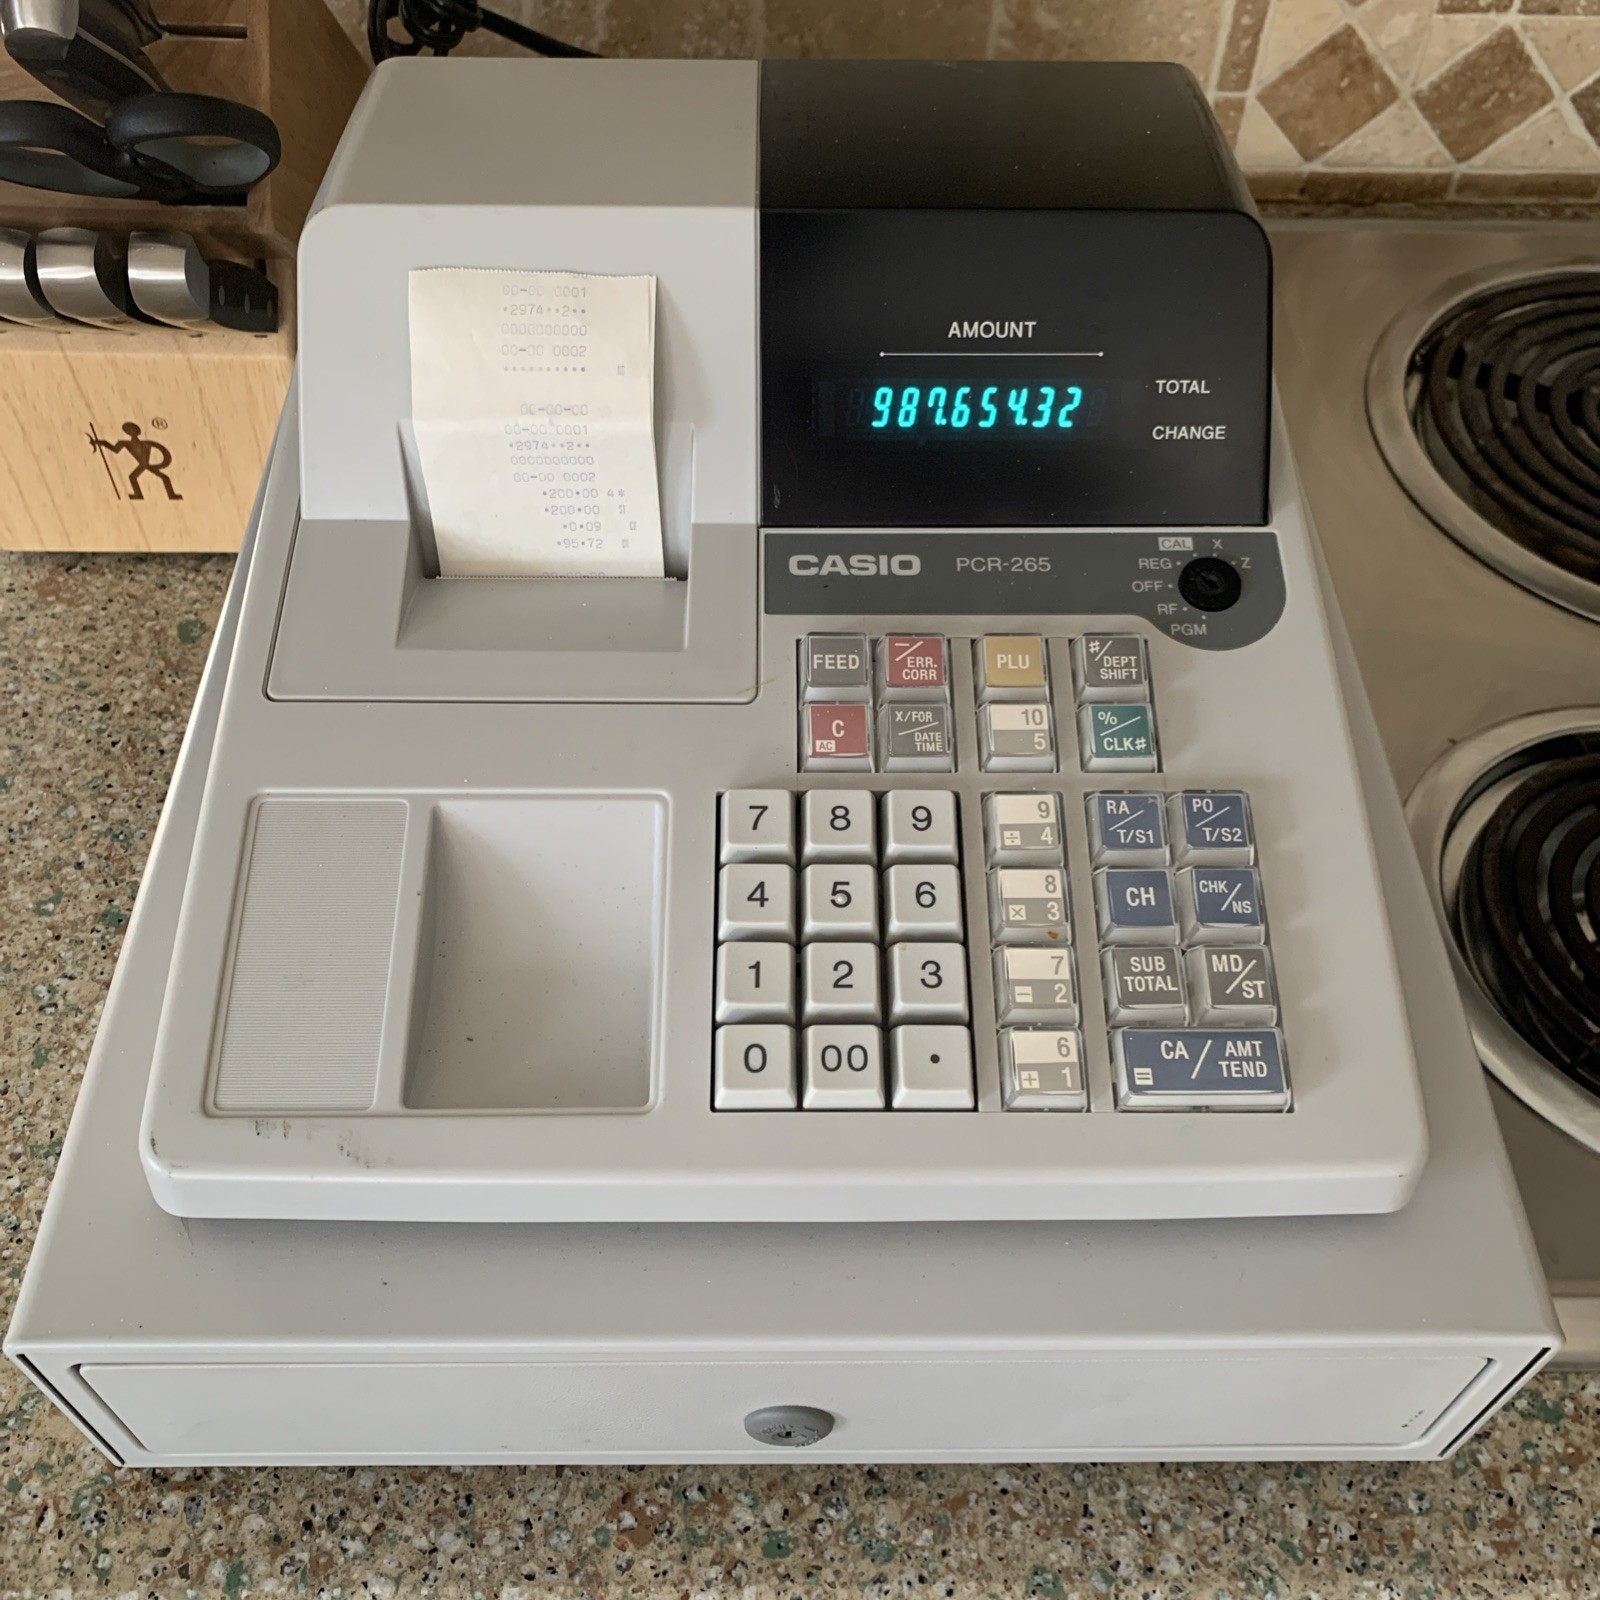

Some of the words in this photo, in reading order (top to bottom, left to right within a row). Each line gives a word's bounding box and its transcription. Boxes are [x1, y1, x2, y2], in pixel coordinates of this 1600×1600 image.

[948, 321, 1037, 339] AMOUNT
[553, 344, 587, 358] 0002
[1155, 379, 1211, 395] TOTAL
[555, 424, 588, 436] 0001
[1151, 426, 1227, 441] CHANGE
[563, 472, 596, 483] 0002
[1161, 539, 1191, 549] CAL
[1212, 539, 1223, 549] X
[788, 554, 921, 576] CASIO
[956, 557, 1051, 572] PCR-265
[1138, 558, 1172, 569] REG
[1240, 557, 1251, 569] Z
[1132, 581, 1163, 592] OFF
[1157, 603, 1178, 615] RF
[1171, 623, 1207, 635] PGM
[813, 654, 860, 670] FEED
[906, 656, 938, 668] ERR.
[997, 654, 1030, 669] PLU
[1103, 656, 1138, 667] DEPT
[902, 669, 937, 680] CORR
[1100, 668, 1138, 680] SHIFT
[895, 711, 933, 722] X/FOR
[1021, 709, 1044, 726] 10
[831, 720, 845, 737] C
[914, 732, 942, 742] DATE
[1034, 733, 1046, 750] 5
[1103, 737, 1147, 751] CLK#
[818, 741, 834, 751] AC
[915, 742, 943, 752] TIME
[1037, 801, 1050, 819] 9
[1106, 800, 1130, 814] RA
[748, 805, 769, 831] 7
[829, 805, 851, 831] 8
[911, 805, 933, 831] 9
[1040, 826, 1054, 845] 4
[1116, 829, 1154, 844] T/S1
[1202, 828, 1243, 842] T/S2
[1044, 875, 1057, 893] 8
[1199, 880, 1228, 893] CHK
[746, 881, 769, 908] 4
[830, 881, 852, 908] 5
[915, 881, 936, 908] 6
[1125, 887, 1156, 906] CH
[1047, 901, 1060, 920] 3
[1232, 901, 1252, 914] NS
[1050, 956, 1064, 975] 7
[1130, 957, 1166, 972] SUB
[1212, 955, 1243, 972] MD
[748, 960, 761, 988] 1
[832, 960, 854, 989] 2
[920, 960, 943, 989] 3
[1124, 976, 1178, 992] TOTAL
[1241, 981, 1265, 998] ST
[1054, 983, 1067, 1003] 2
[1057, 1037, 1070, 1058] 6
[1161, 1040, 1190, 1059] CA
[1225, 1041, 1262, 1057] AMT
[743, 1043, 767, 1073] 0
[820, 1045, 868, 1072] 00
[1061, 1066, 1072, 1088] 1
[1218, 1061, 1268, 1078] TEND
